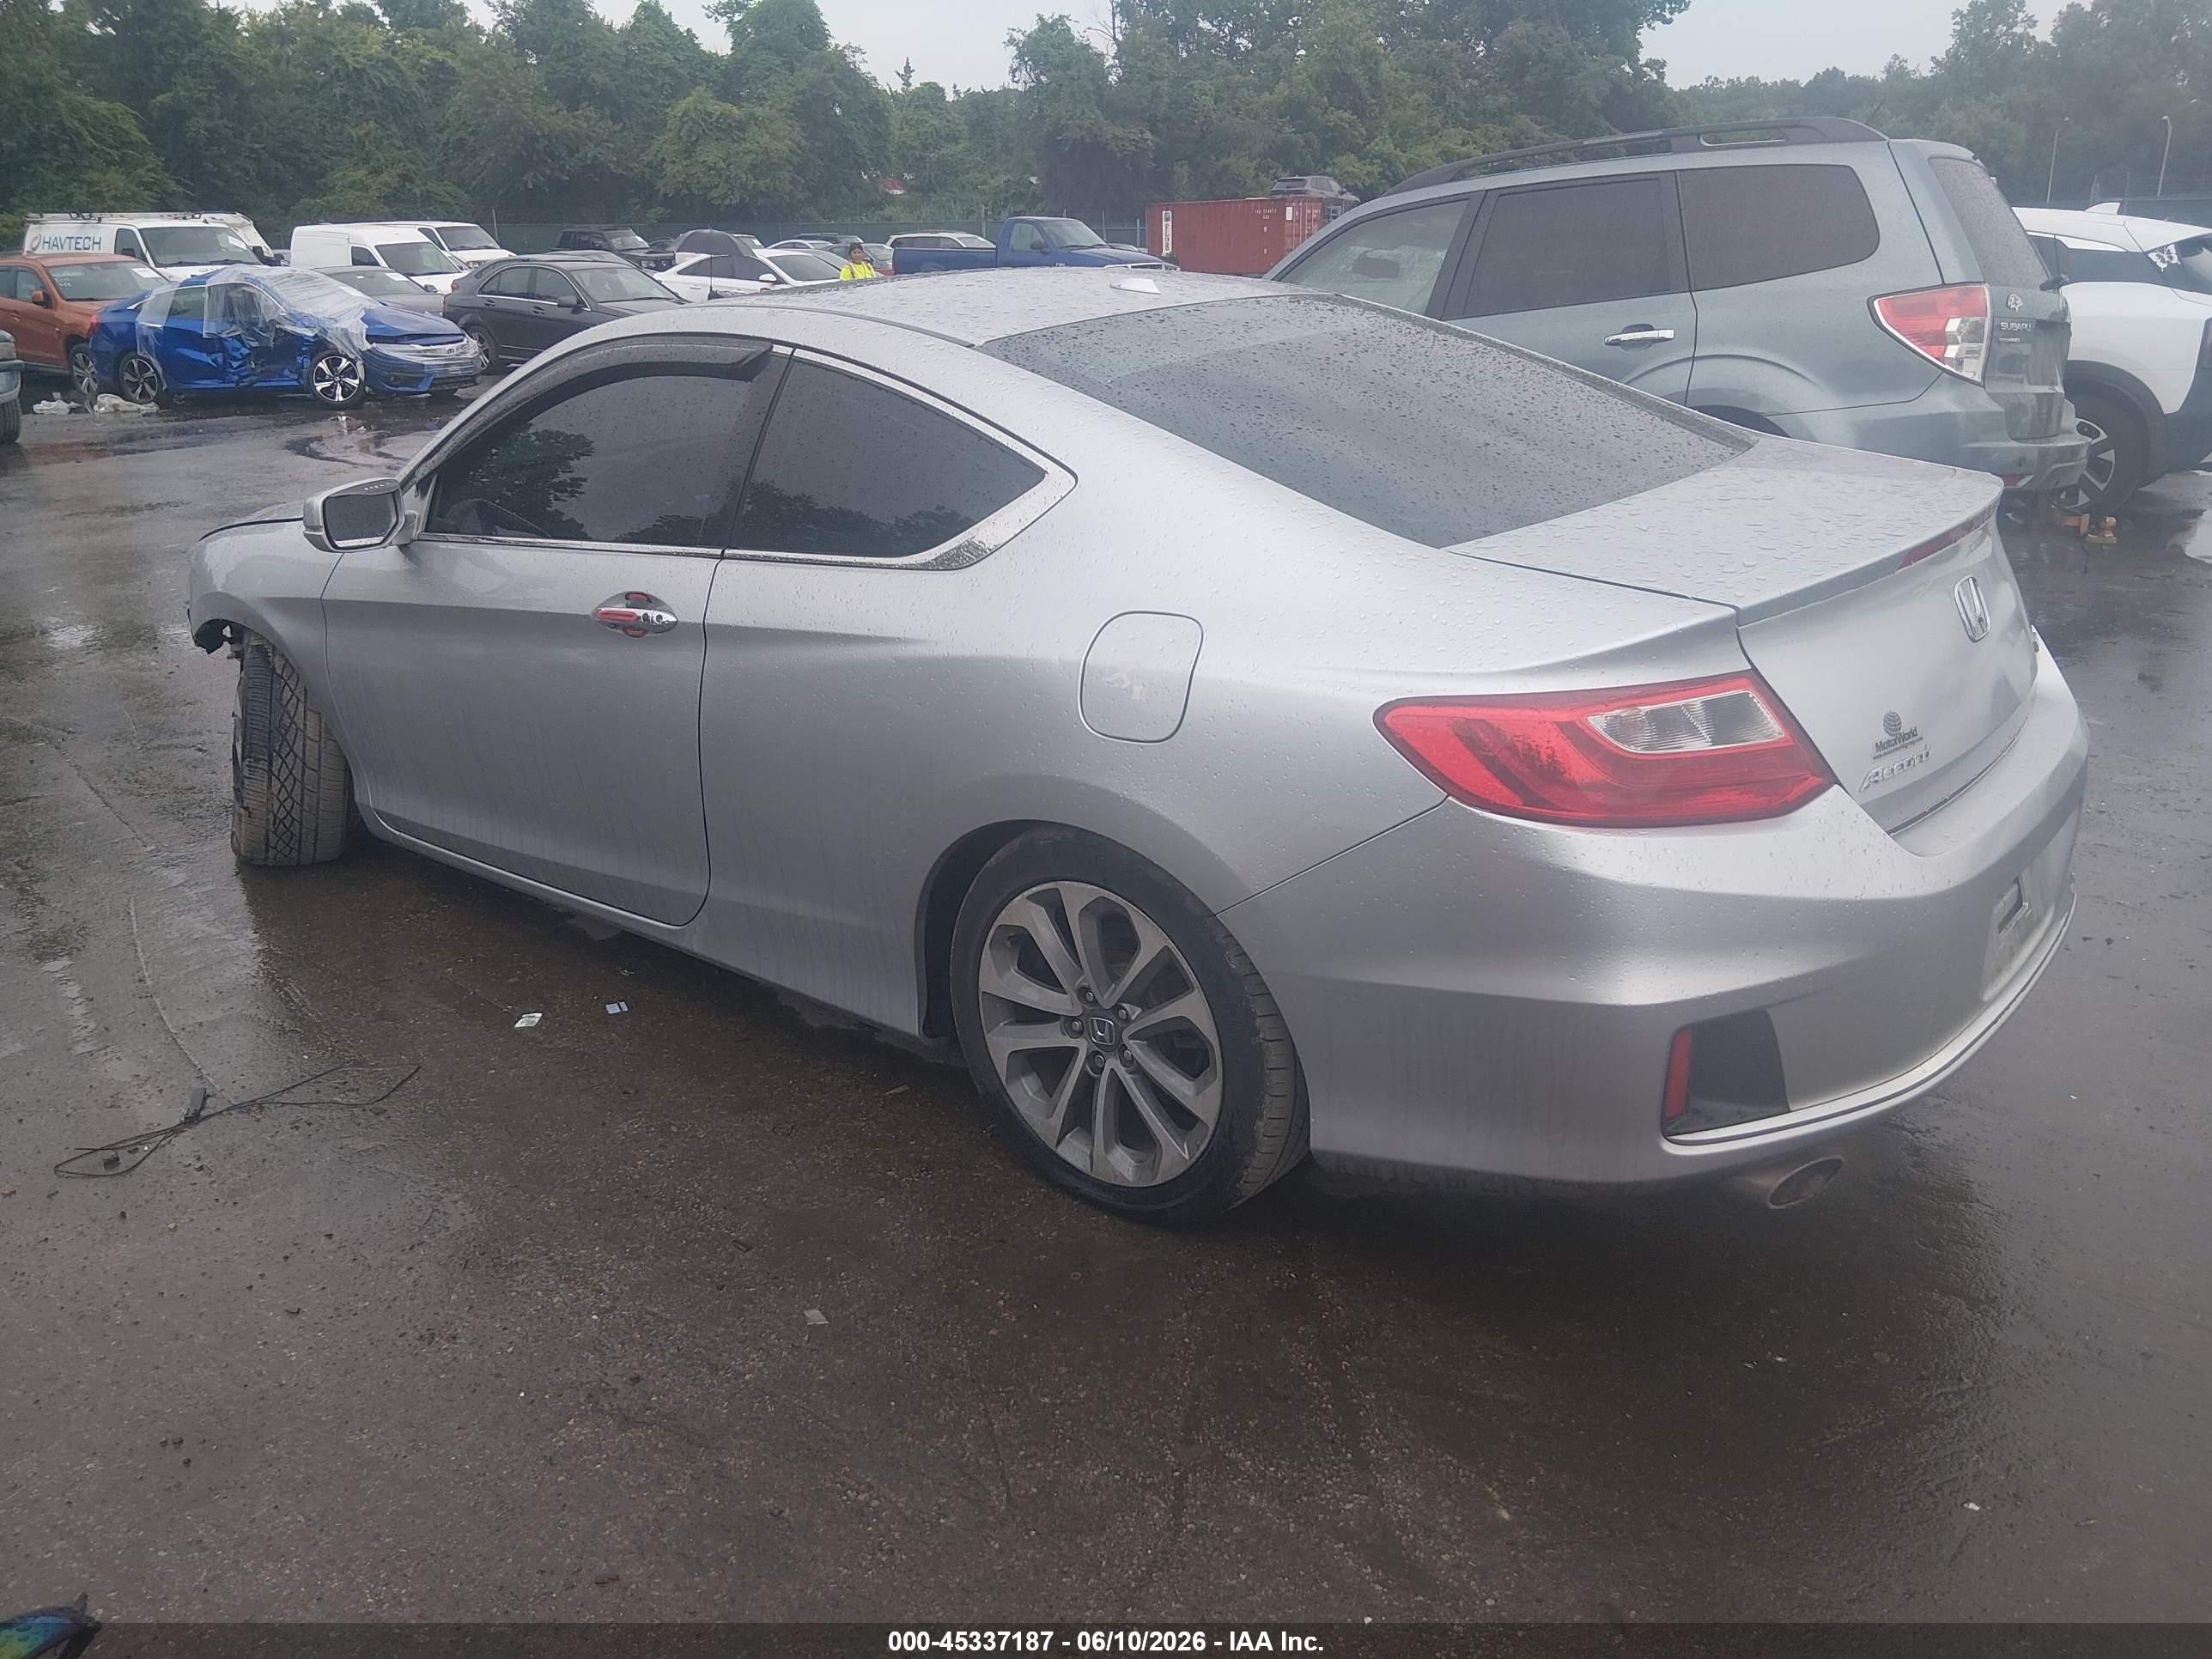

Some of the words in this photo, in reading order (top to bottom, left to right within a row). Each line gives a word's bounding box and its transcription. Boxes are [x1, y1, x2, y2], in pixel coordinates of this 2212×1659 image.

[42, 236, 101, 251] HAVTECH
[2000, 322, 2032, 331] SUBARU
[1875, 726, 1918, 753] MotorWorld
[1858, 743, 1930, 793] Accord
